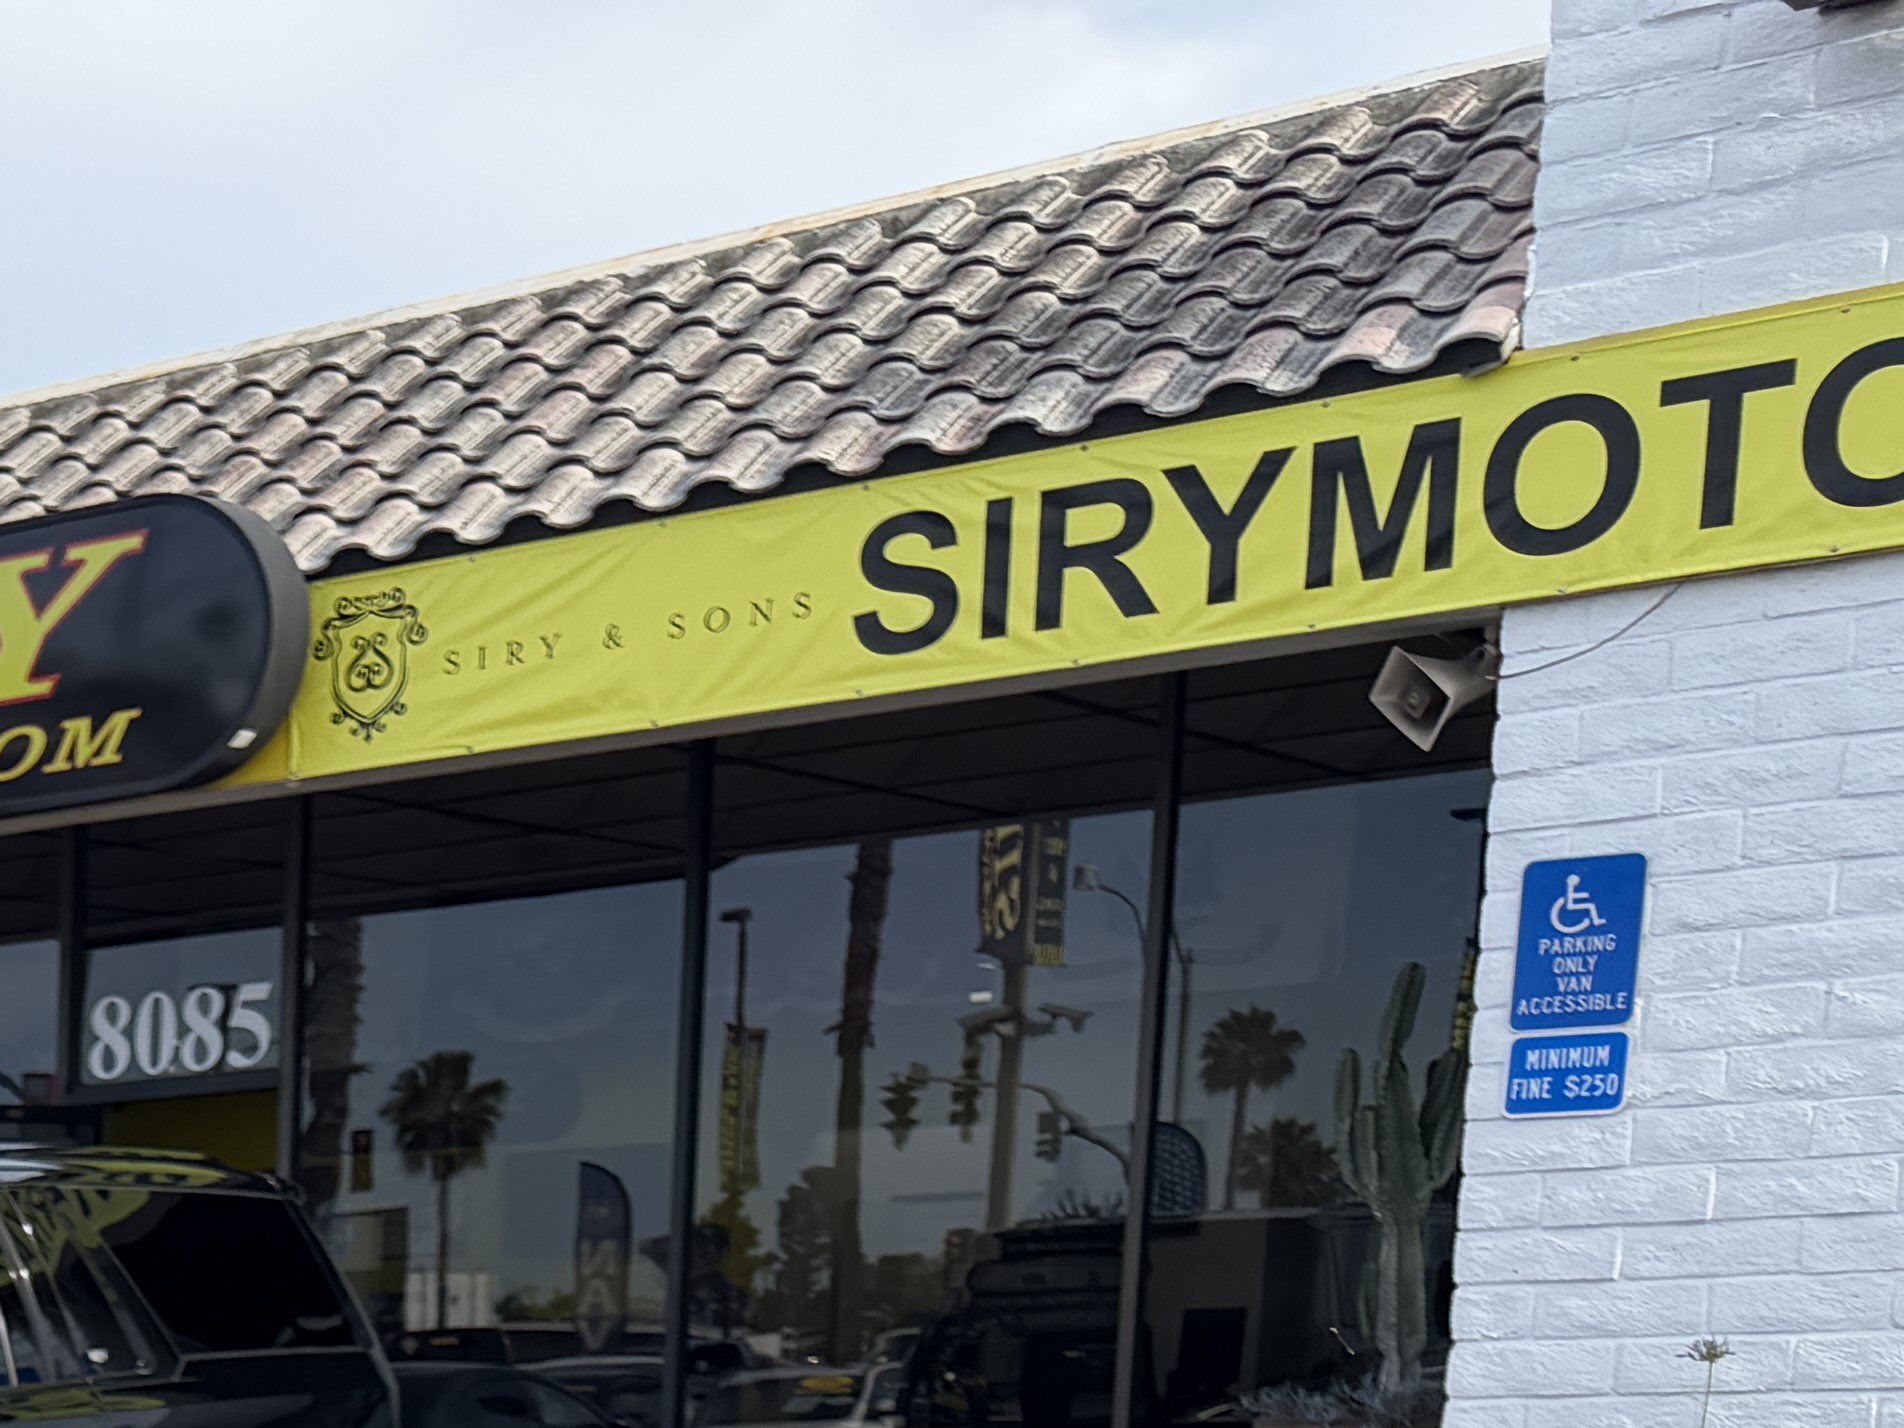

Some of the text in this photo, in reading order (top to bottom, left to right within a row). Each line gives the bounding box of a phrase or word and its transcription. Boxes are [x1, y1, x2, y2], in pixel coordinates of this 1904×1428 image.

[442, 592, 812, 675] SIRY & SONS
[1539, 934, 1616, 955] PARKING
[1553, 955, 1599, 974] ONLY
[1557, 975, 1592, 992] VAN
[1516, 992, 1628, 1015] ACCESSIBLE
[88, 981, 274, 1080] 8085
[1525, 1045, 1610, 1071] MINIMUM
[1510, 1073, 1619, 1100] FINE $250
